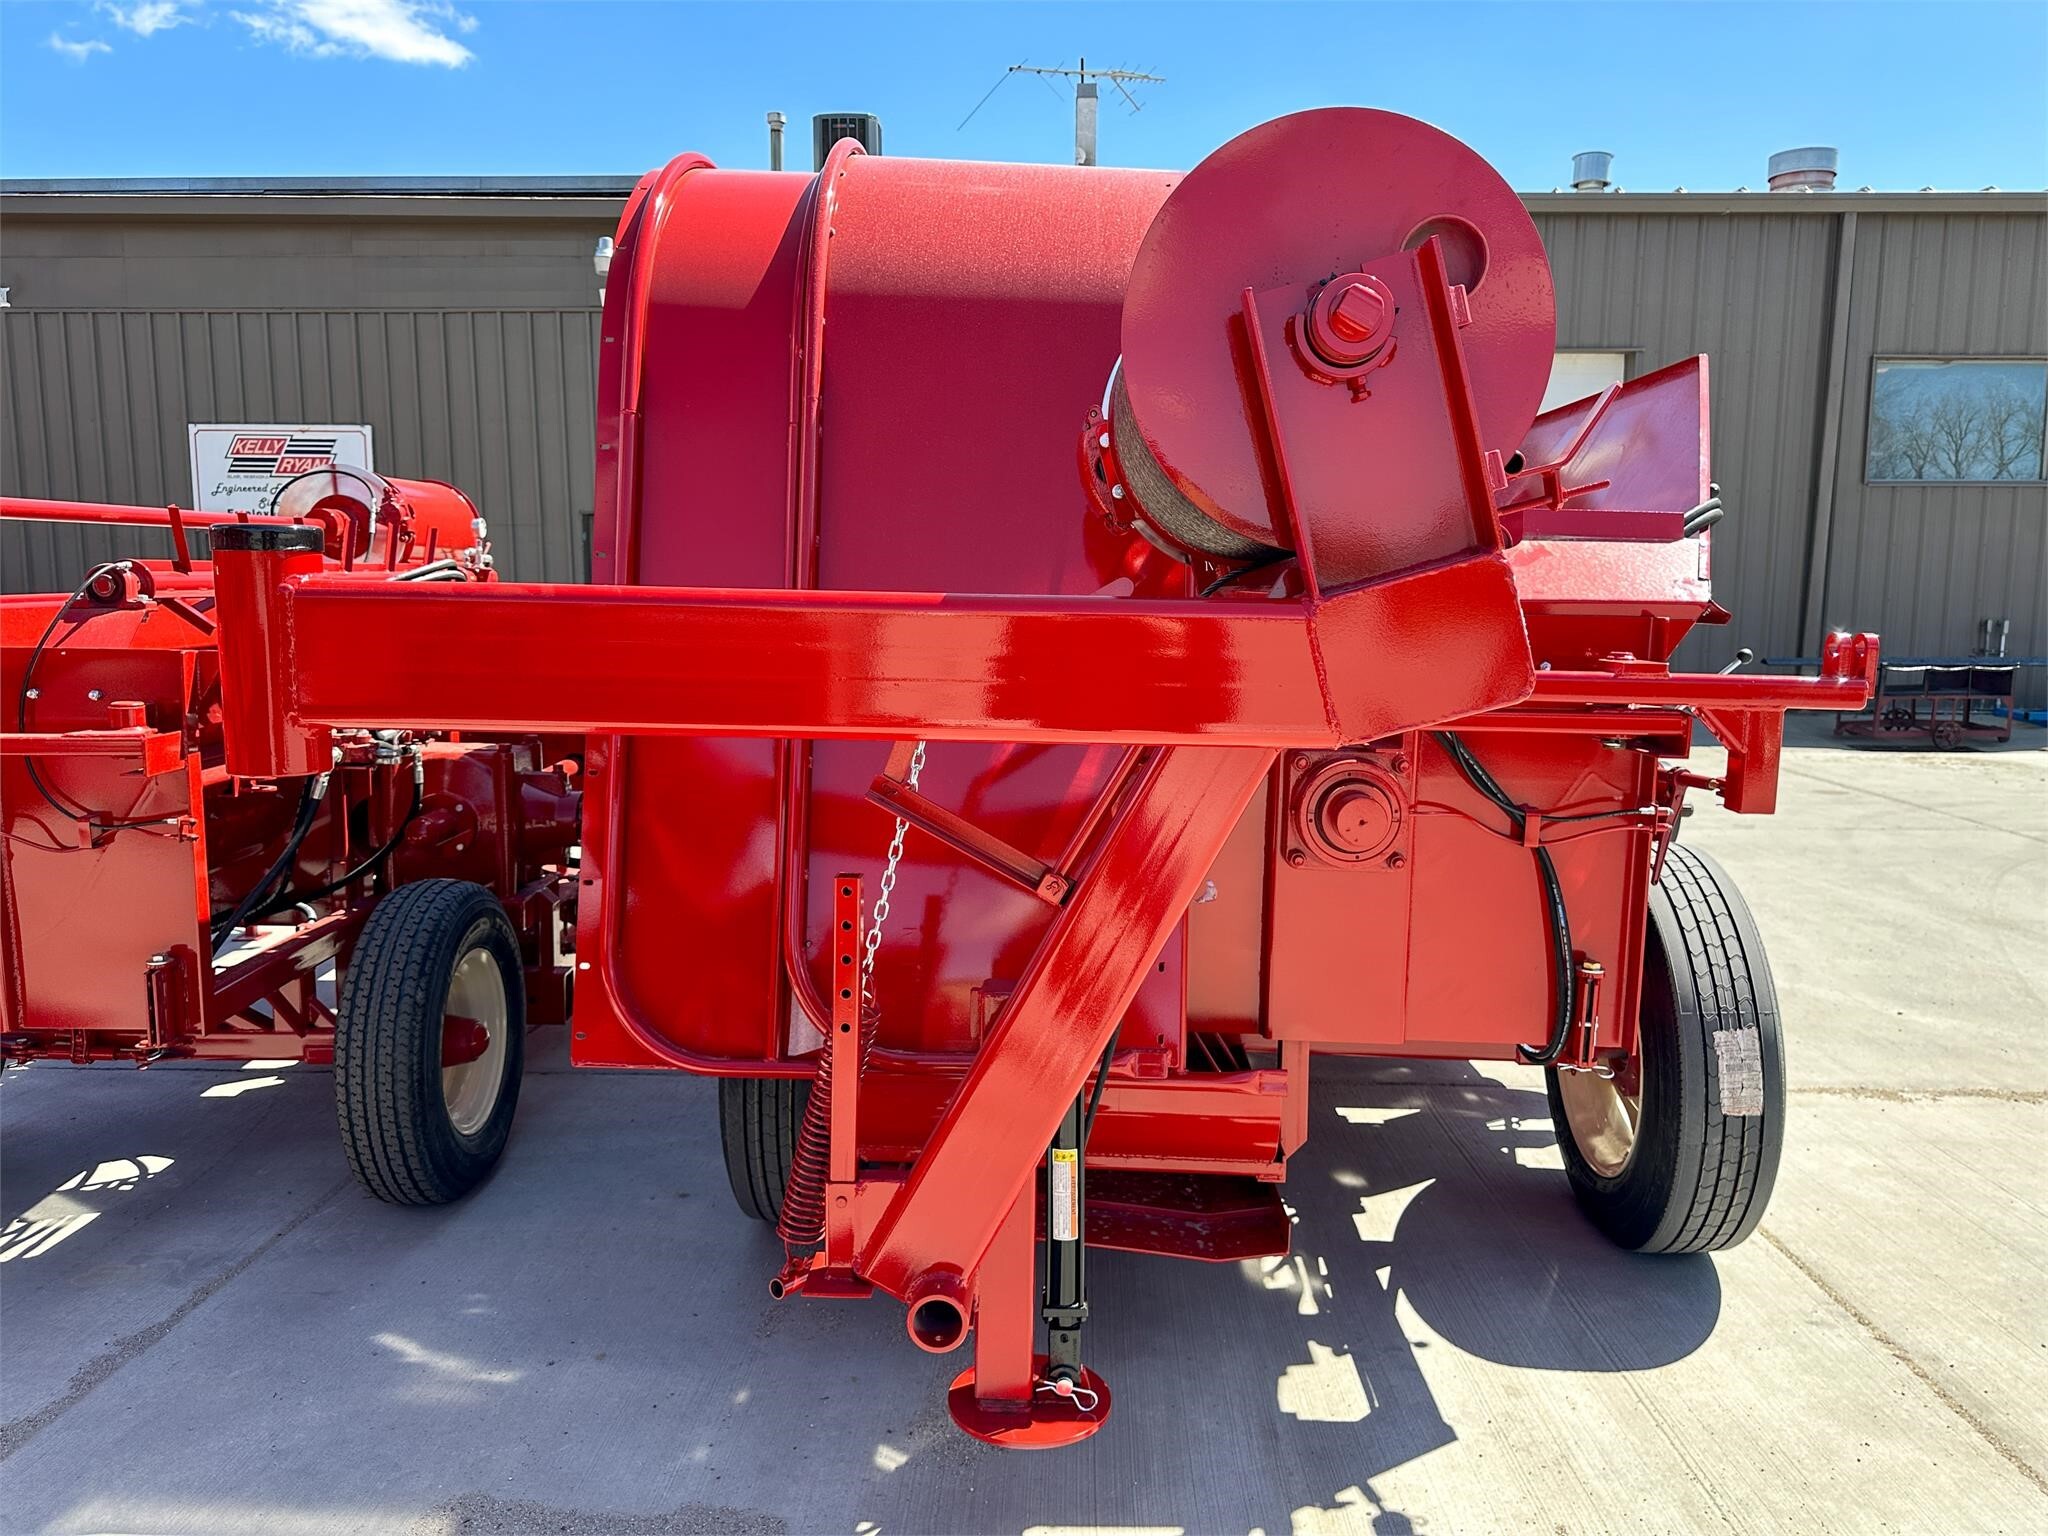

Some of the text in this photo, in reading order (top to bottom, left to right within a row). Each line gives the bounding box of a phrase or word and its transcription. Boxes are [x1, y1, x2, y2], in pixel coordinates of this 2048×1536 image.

[233, 439, 285, 454] KELLY
[279, 458, 328, 473] RYAN
[211, 482, 269, 497] Engineered
